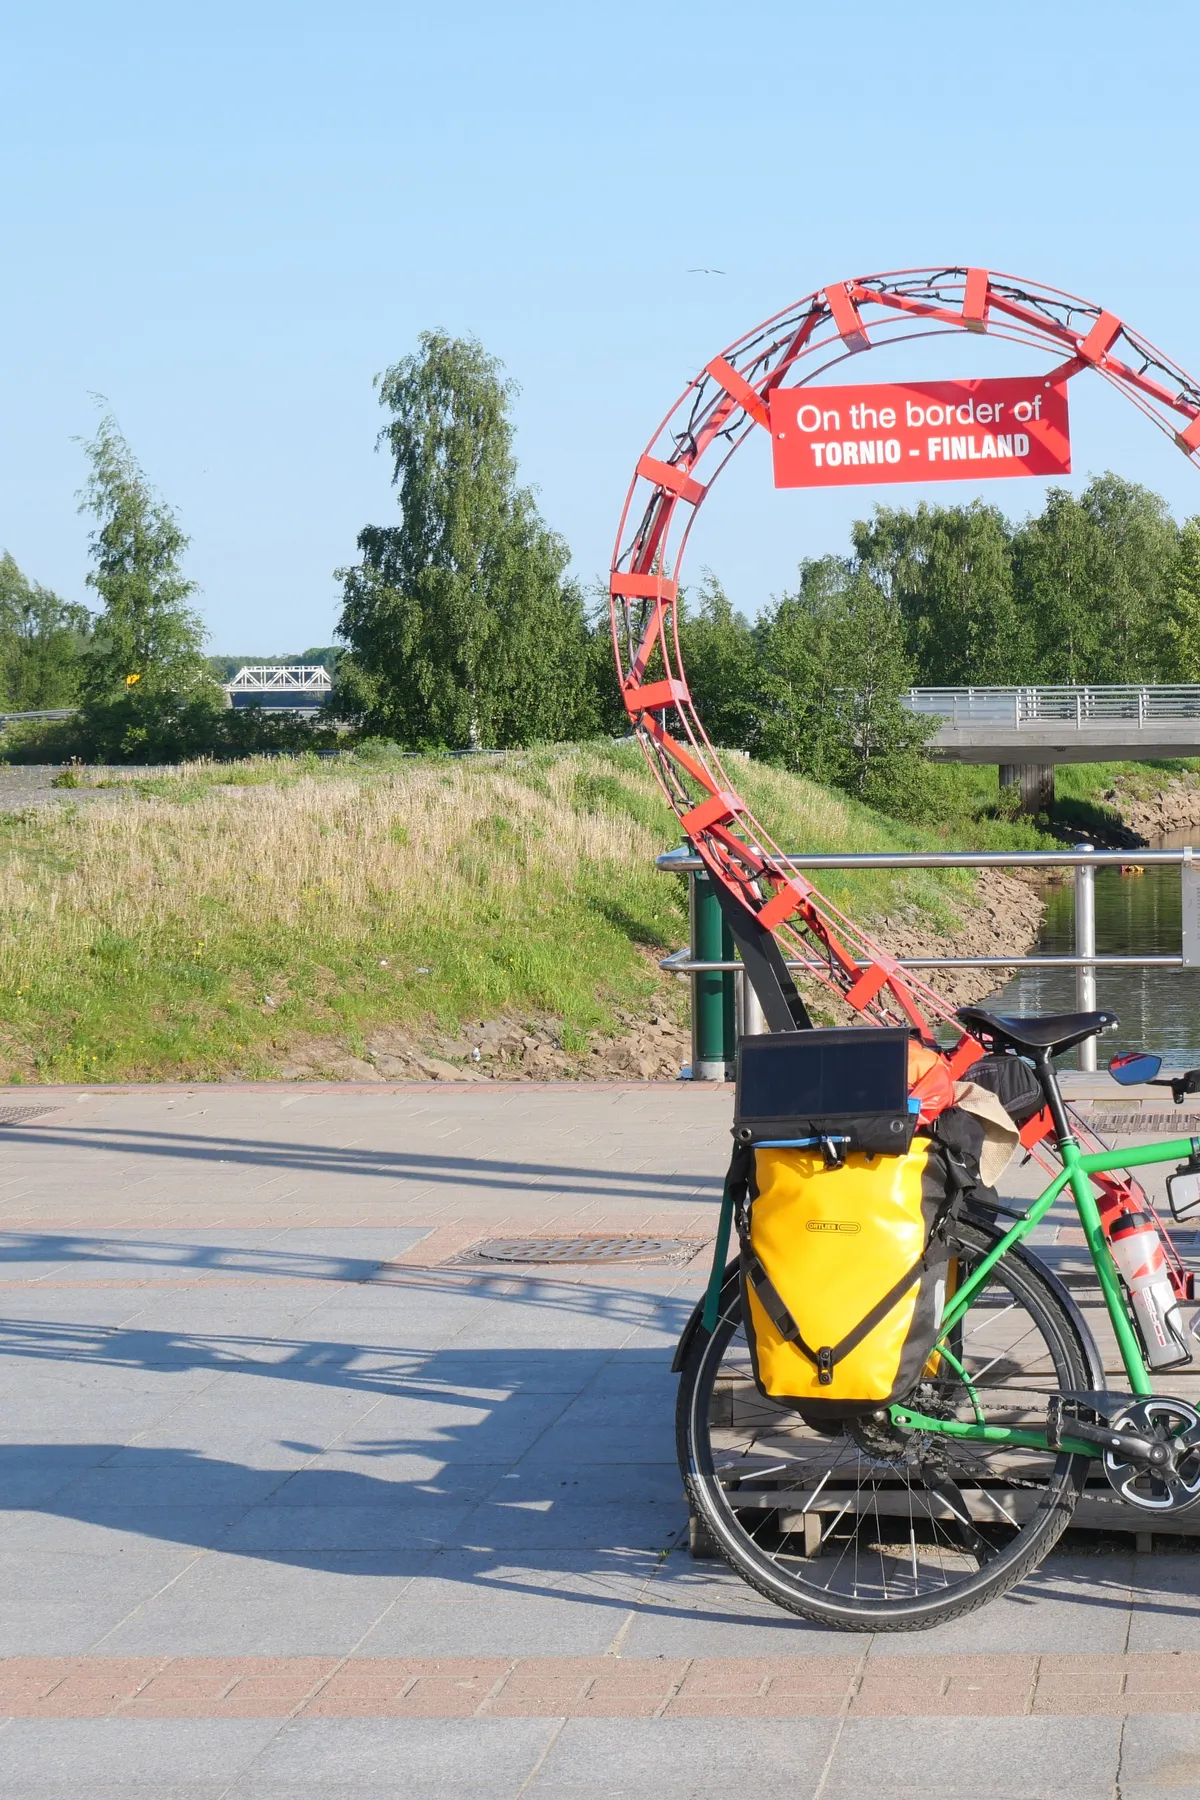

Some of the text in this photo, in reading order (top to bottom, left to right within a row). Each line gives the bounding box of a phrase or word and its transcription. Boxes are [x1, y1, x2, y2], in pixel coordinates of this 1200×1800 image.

[796, 394, 1043, 433] On the border of
[810, 433, 1030, 467] TORNIO - FINLAND
